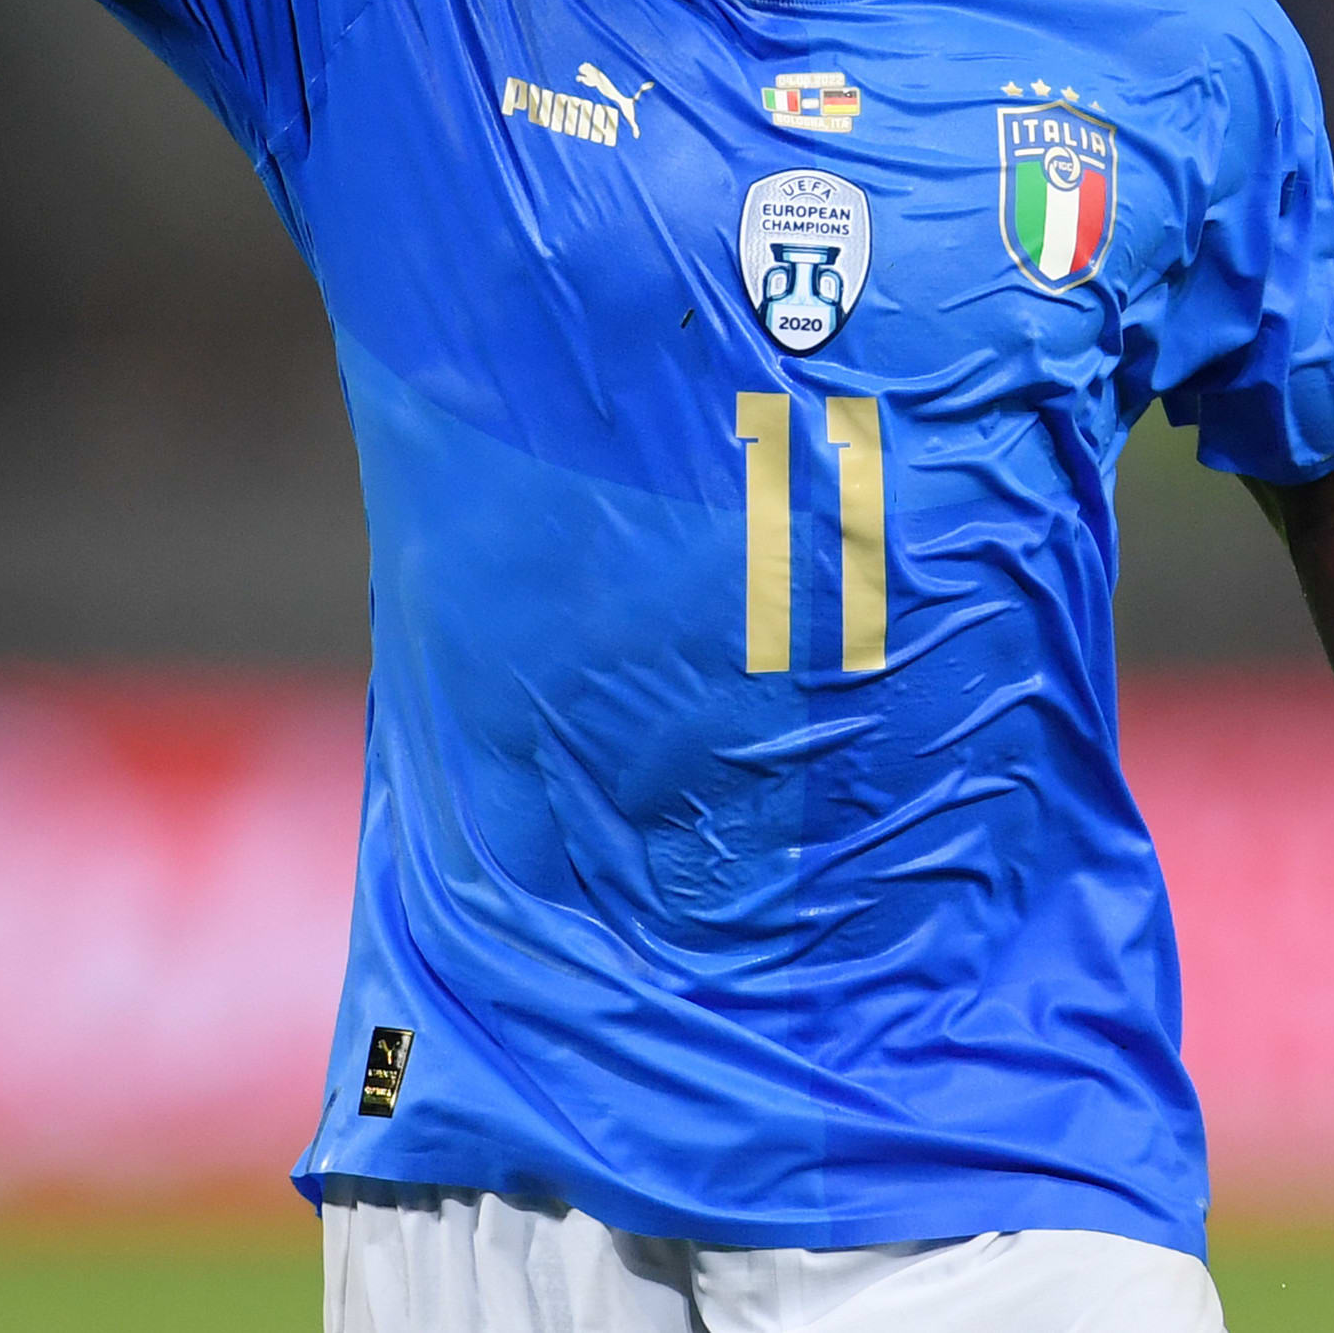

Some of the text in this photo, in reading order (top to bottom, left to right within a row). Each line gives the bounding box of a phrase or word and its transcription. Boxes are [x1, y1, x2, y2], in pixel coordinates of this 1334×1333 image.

[501, 77, 619, 147] PUMA
[1012, 119, 1106, 157] ITALIA
[782, 179, 832, 200] UEFA
[762, 203, 851, 221] EUROPEAN
[762, 219, 850, 235] CHAMPIONS
[778, 316, 823, 332] 2020
[736, 392, 887, 673] 11
